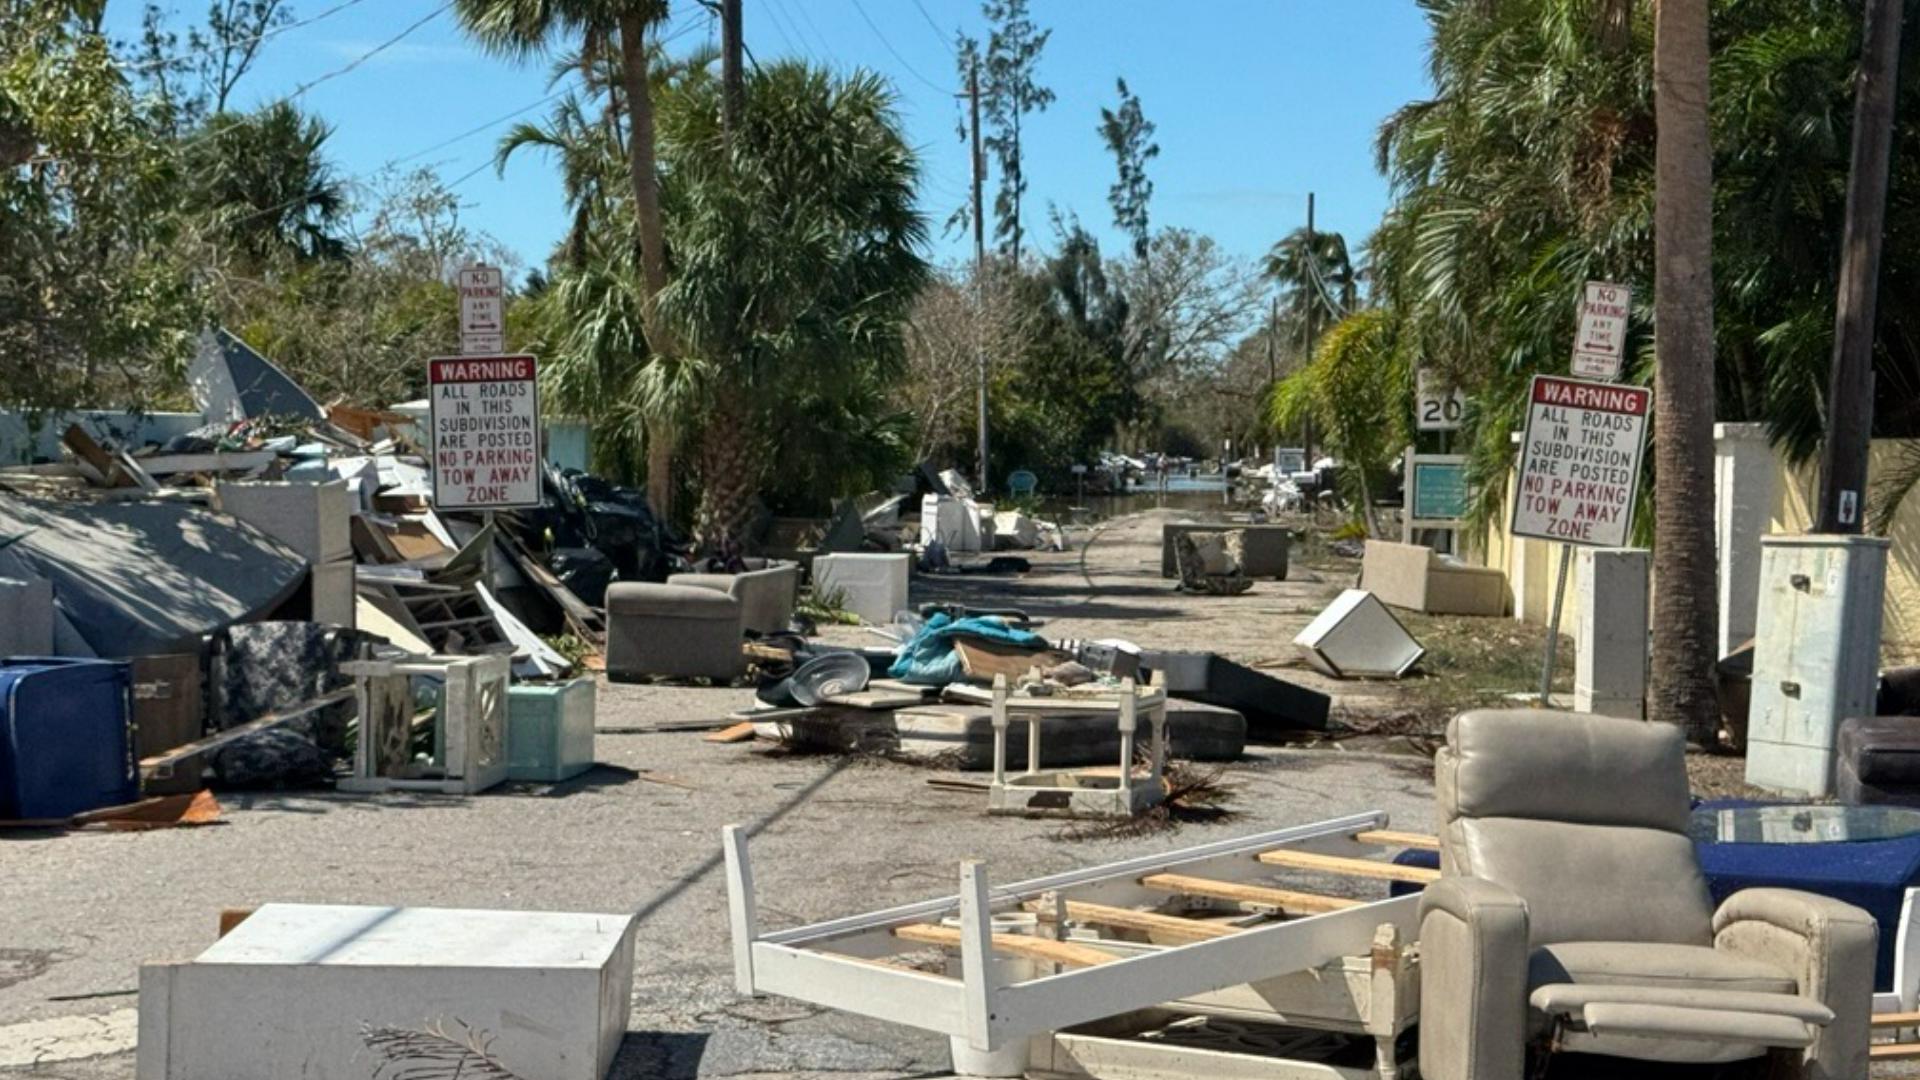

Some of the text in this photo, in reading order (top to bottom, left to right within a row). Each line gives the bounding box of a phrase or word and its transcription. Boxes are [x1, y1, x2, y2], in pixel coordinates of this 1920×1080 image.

[472, 273, 489, 284] NO
[462, 287, 500, 297] PARKING
[1598, 287, 1616, 302] NO
[1584, 303, 1626, 318] PARKING
[440, 361, 527, 380] WARNING
[442, 383, 526, 399] ALL ROADS
[1544, 383, 1637, 411] WARNING
[457, 400, 512, 415] IN THIS
[1424, 400, 1461, 422] 20
[440, 416, 531, 433] SUBDIVISION
[1541, 407, 1633, 432] ALL ROADS
[440, 432, 532, 448] ARE POSTED
[1553, 425, 1616, 447] IN THIS
[440, 449, 533, 466] NO PARKING
[1532, 440, 1631, 467] SUBDIVISION
[442, 467, 530, 485] TOW AWAY
[1528, 458, 1629, 485] ARE POSTED
[466, 486, 508, 502] ZONE
[1525, 475, 1627, 505] NO PARKING
[1525, 494, 1622, 523] TOW AWAY
[1546, 517, 1593, 540] ZONE
